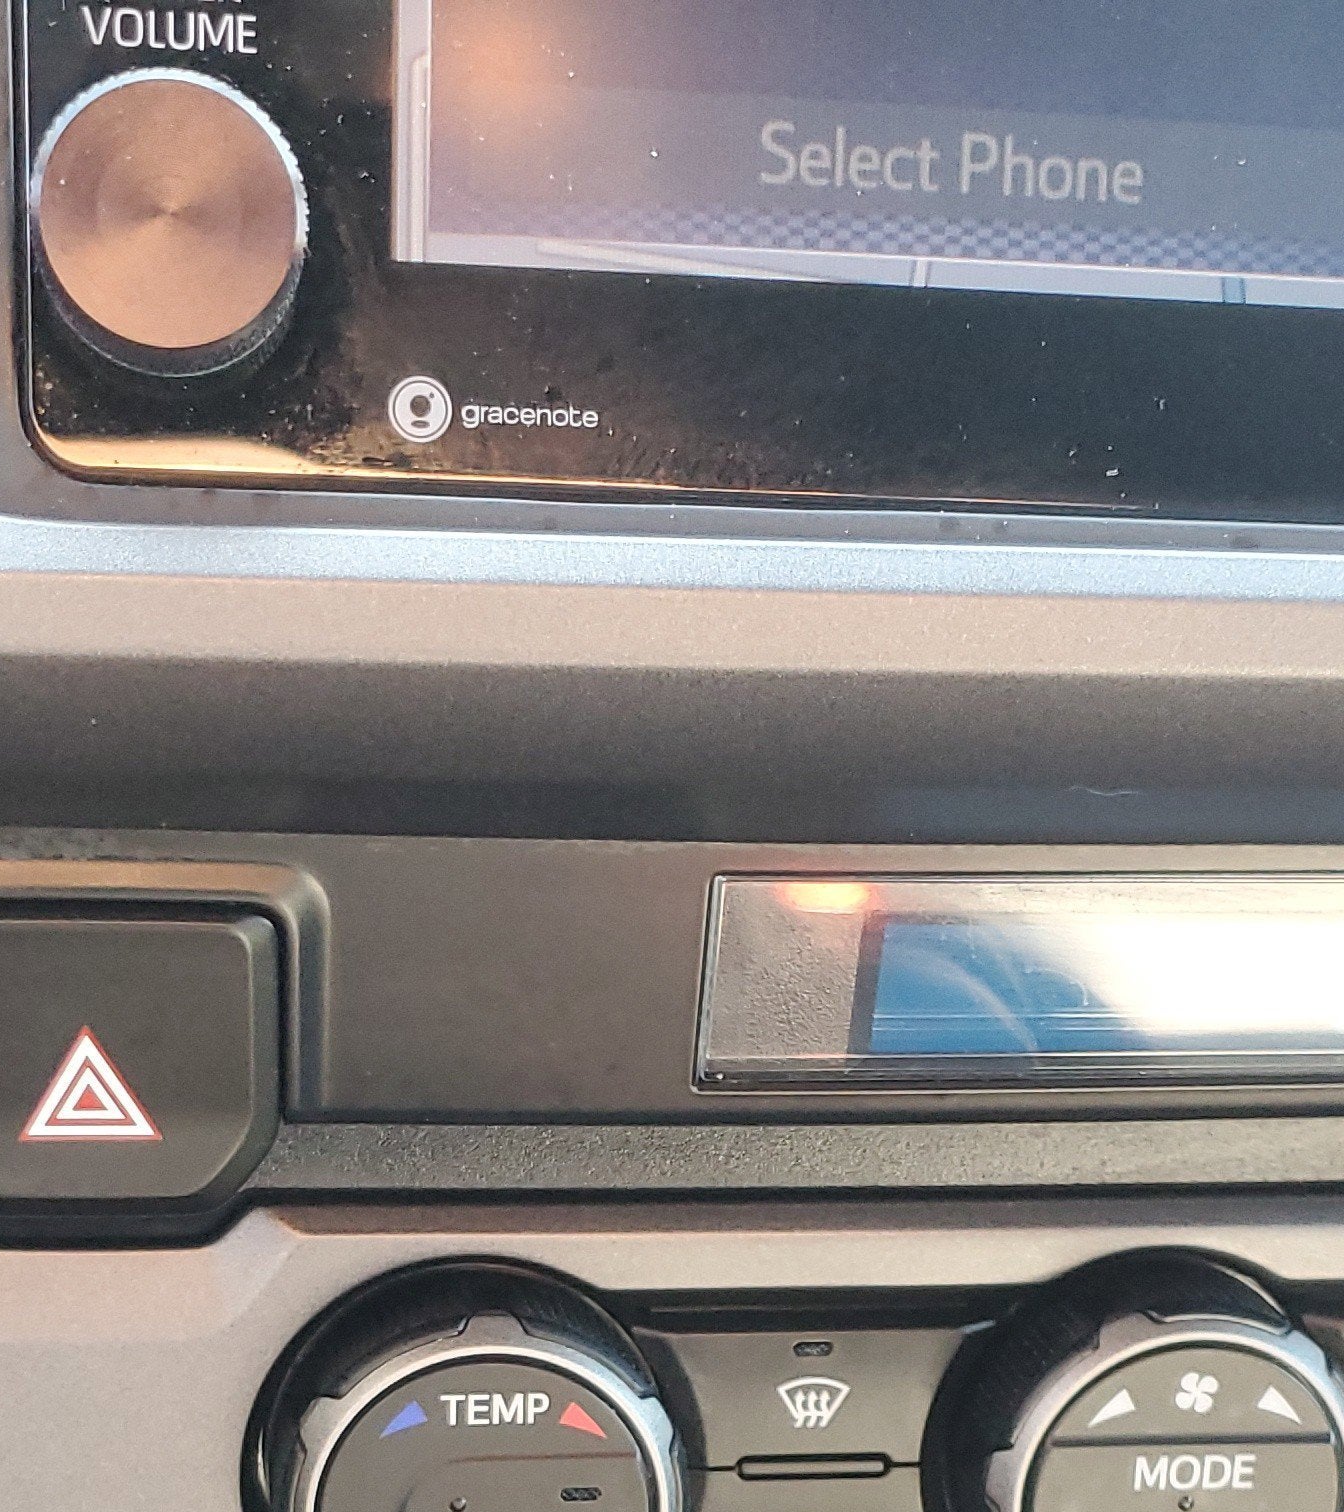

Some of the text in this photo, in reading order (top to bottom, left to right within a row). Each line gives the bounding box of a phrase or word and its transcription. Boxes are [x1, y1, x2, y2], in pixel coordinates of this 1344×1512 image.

[80, 5, 258, 55] VOLUME
[759, 119, 1145, 206] Select Phone
[460, 402, 600, 429] gracenote
[439, 1392, 551, 1427] TEMP
[1132, 1453, 1257, 1492] MODE
